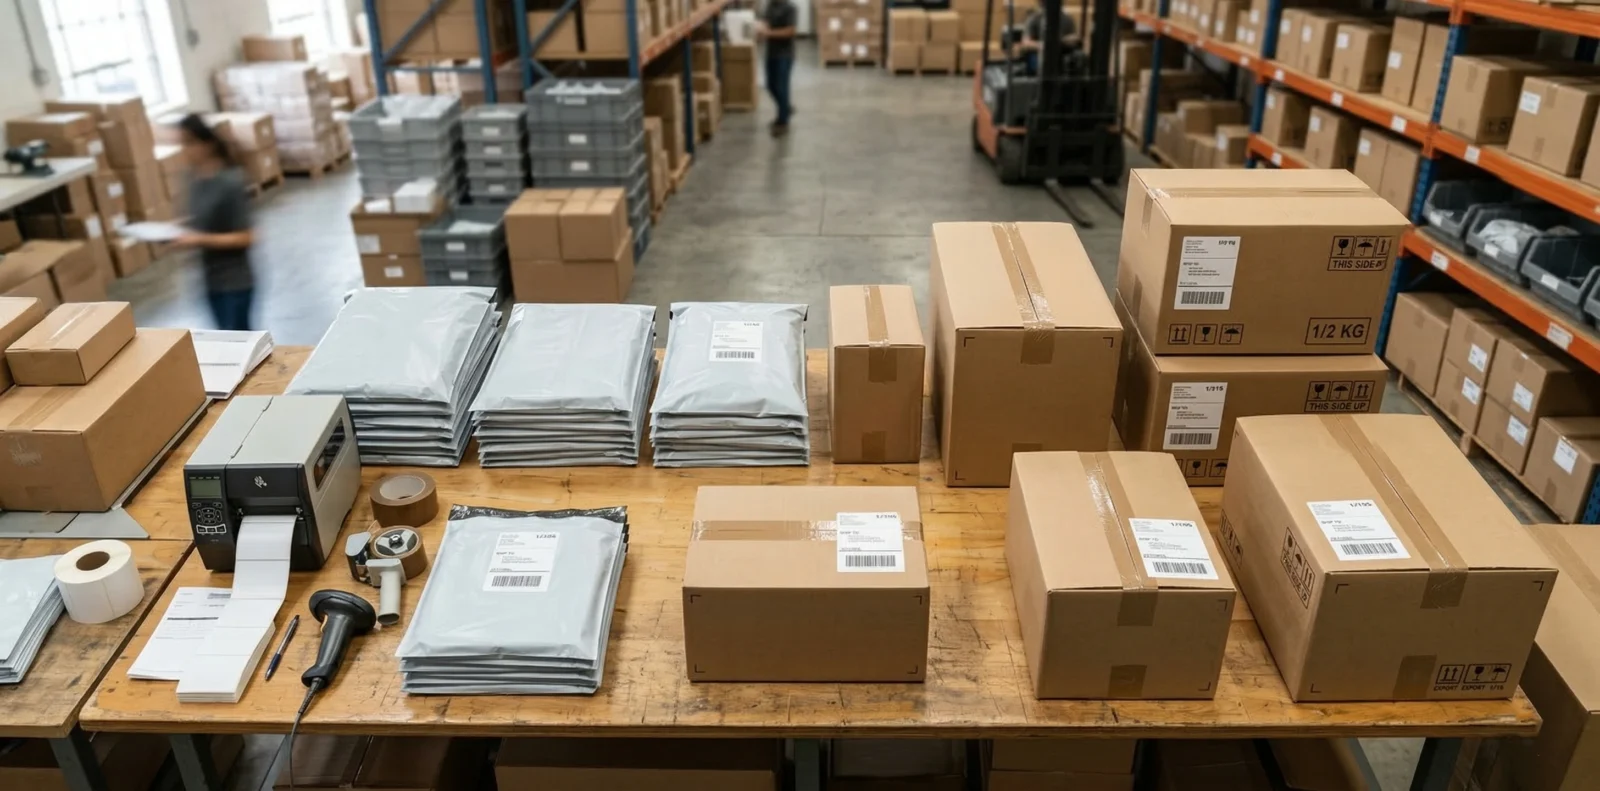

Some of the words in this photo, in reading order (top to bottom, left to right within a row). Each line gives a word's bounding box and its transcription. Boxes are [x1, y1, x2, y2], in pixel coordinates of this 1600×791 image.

[1333, 260, 1353, 269] THIS
[1355, 260, 1376, 269] SIDE
[1313, 324, 1336, 338] 1/2
[1341, 324, 1365, 338] KG
[1309, 402, 1329, 410] THIS
[1331, 402, 1352, 410] SIDE
[1353, 402, 1367, 410] UP
